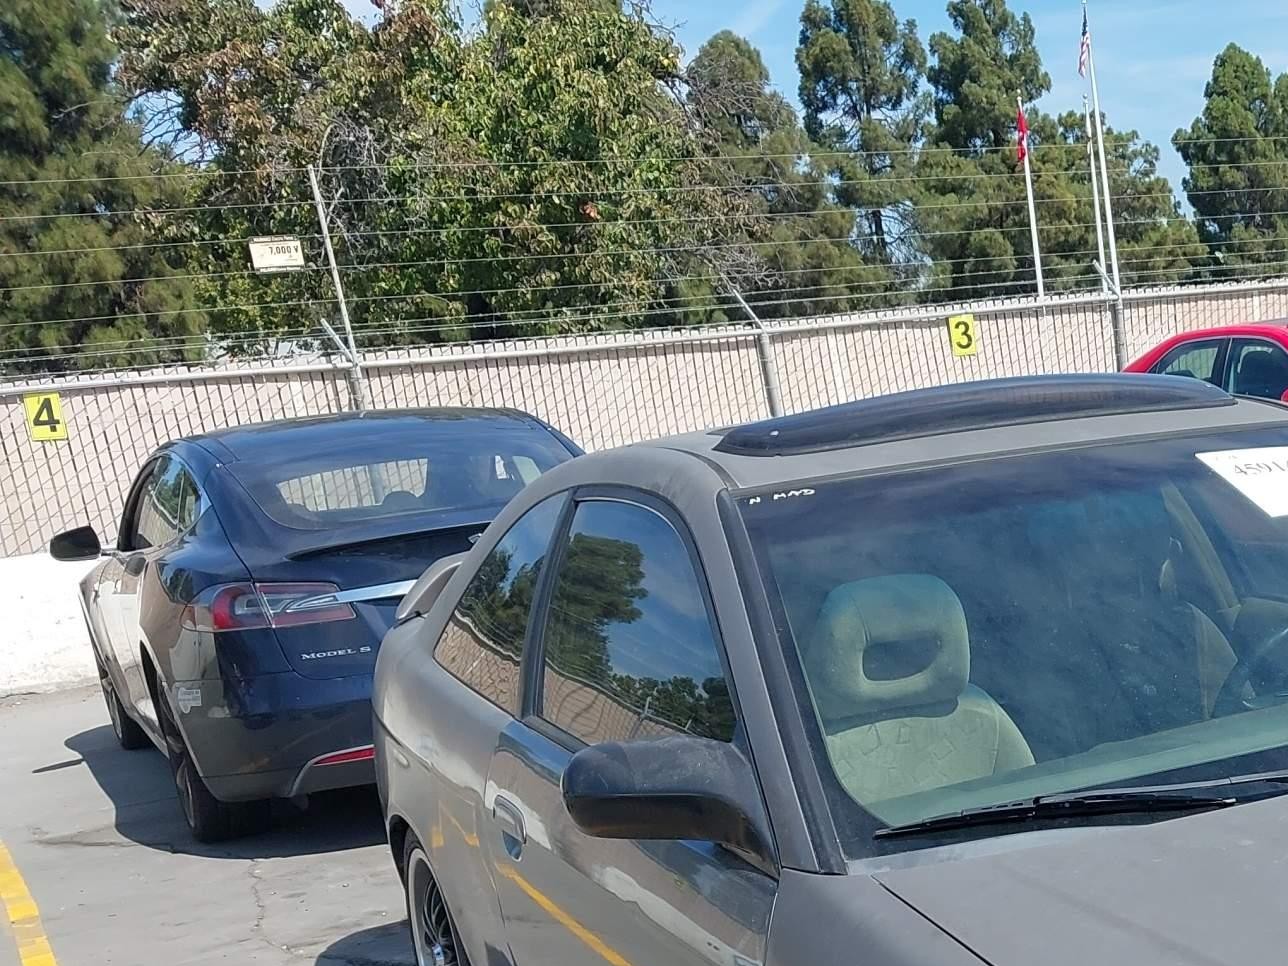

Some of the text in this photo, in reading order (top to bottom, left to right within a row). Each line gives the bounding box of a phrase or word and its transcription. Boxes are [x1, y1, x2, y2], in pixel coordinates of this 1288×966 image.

[268, 245, 292, 256] 7,000
[954, 321, 973, 349] 3
[33, 398, 60, 432] 4
[301, 648, 357, 660] MODEL
